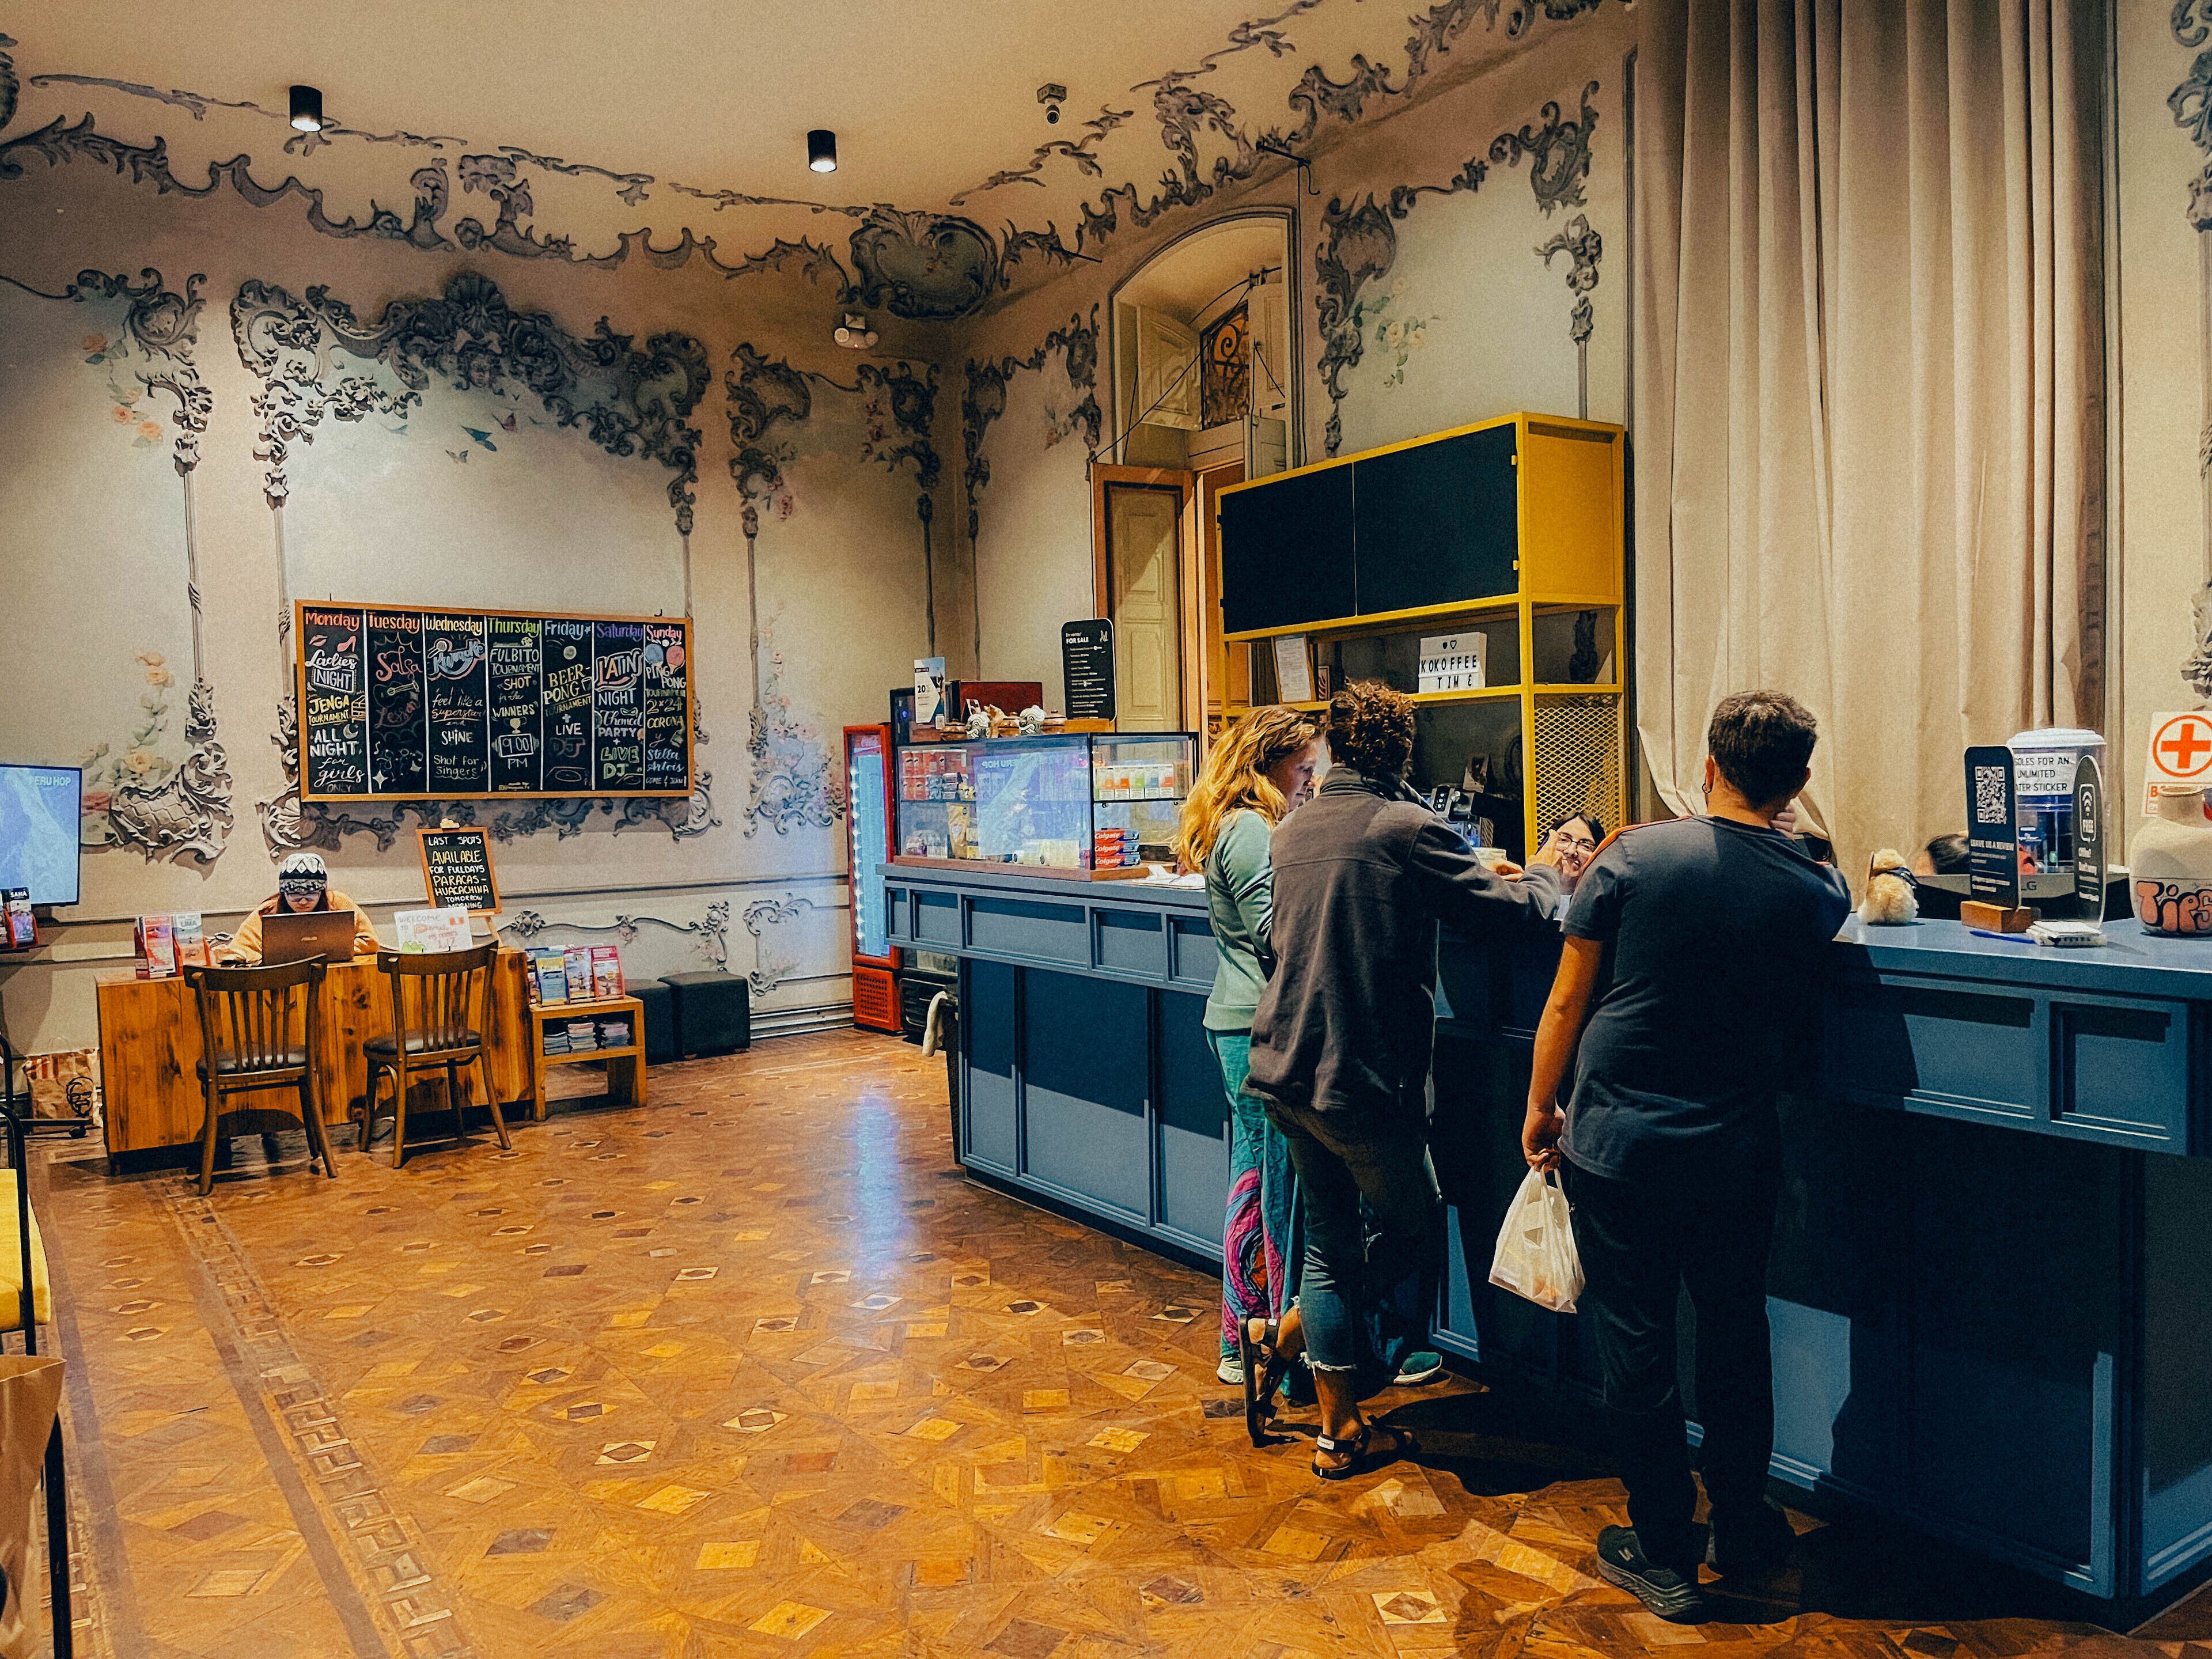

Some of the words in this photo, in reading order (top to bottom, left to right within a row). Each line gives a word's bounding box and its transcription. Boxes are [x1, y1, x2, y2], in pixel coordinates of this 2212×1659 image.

[305, 611, 360, 631] Monday
[368, 612, 420, 634] Tuesday
[426, 616, 482, 636] Wednesday
[488, 618, 540, 638] Thursday
[545, 620, 584, 640] Friday
[597, 623, 643, 642] Saturday
[646, 625, 682, 645] Sunday
[305, 649, 357, 670] Ladies
[490, 648, 539, 662] FULBITO
[376, 646, 423, 681] Salsa
[490, 663, 540, 675] TOURNAMENT
[317, 669, 351, 689] NIGHT
[646, 664, 670, 679] PING
[661, 676, 686, 688] PONG
[543, 681, 579, 704] PONG
[599, 688, 637, 706] NIGHT
[309, 695, 350, 714] JENGA
[432, 694, 452, 708] feel
[545, 696, 591, 717] TOURNAMENT
[315, 728, 342, 743] ALL
[556, 722, 582, 735] LIVE
[598, 728, 637, 737] PARTY
[310, 741, 359, 757] NIGHT
[600, 746, 640, 763] LIVE
[647, 748, 680, 761] Stella
[434, 755, 457, 765] Shot
[463, 756, 479, 766] for
[508, 758, 528, 769] PM
[314, 765, 365, 787] girls
[603, 763, 629, 779] DJ
[53, 777, 71, 786] HOP
[327, 784, 351, 793] ONLY
[2033, 783, 2067, 791] STICKER
[429, 836, 449, 846] LAST
[457, 836, 482, 844] SPOTS
[432, 850, 482, 864] AVAILABLE
[429, 866, 444, 874] FOR
[448, 865, 485, 874] FULLDAYS
[434, 885, 489, 896] HUACACHINA
[399, 915, 441, 923] WELCOME
